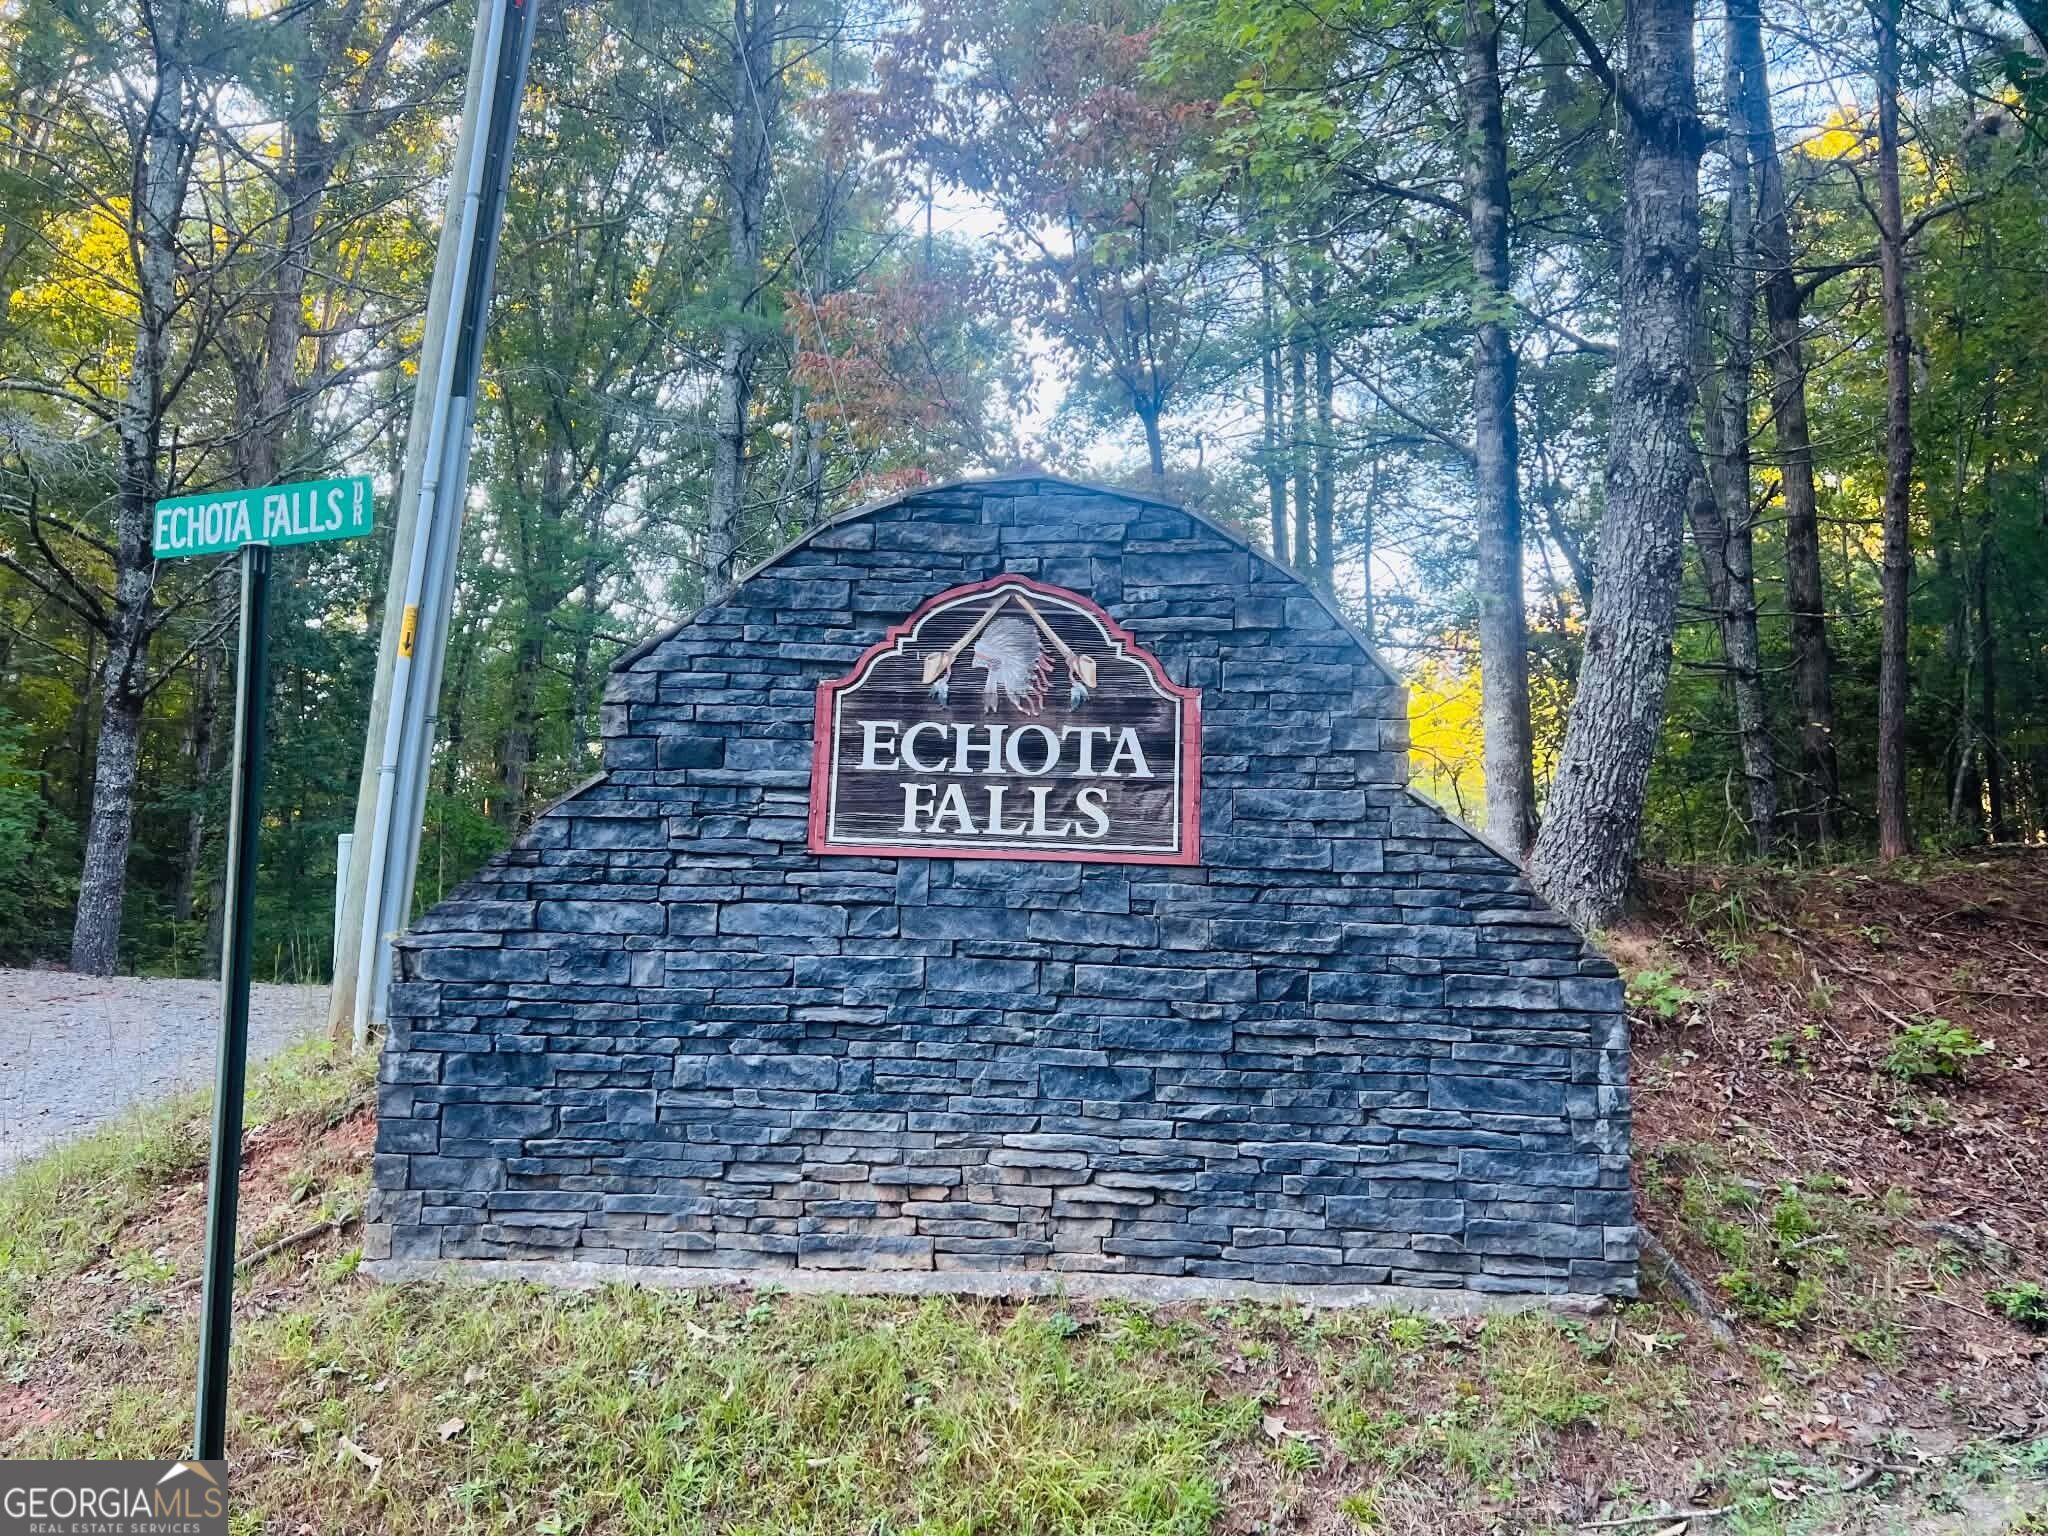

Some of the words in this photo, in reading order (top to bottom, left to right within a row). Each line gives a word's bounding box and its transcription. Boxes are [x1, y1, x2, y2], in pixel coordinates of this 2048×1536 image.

[155, 498, 253, 550] ECHOTA
[262, 487, 345, 538] FALLS
[352, 481, 364, 526] DR
[855, 719, 1154, 778] ECHOTA
[897, 782, 1110, 838] FALLS
